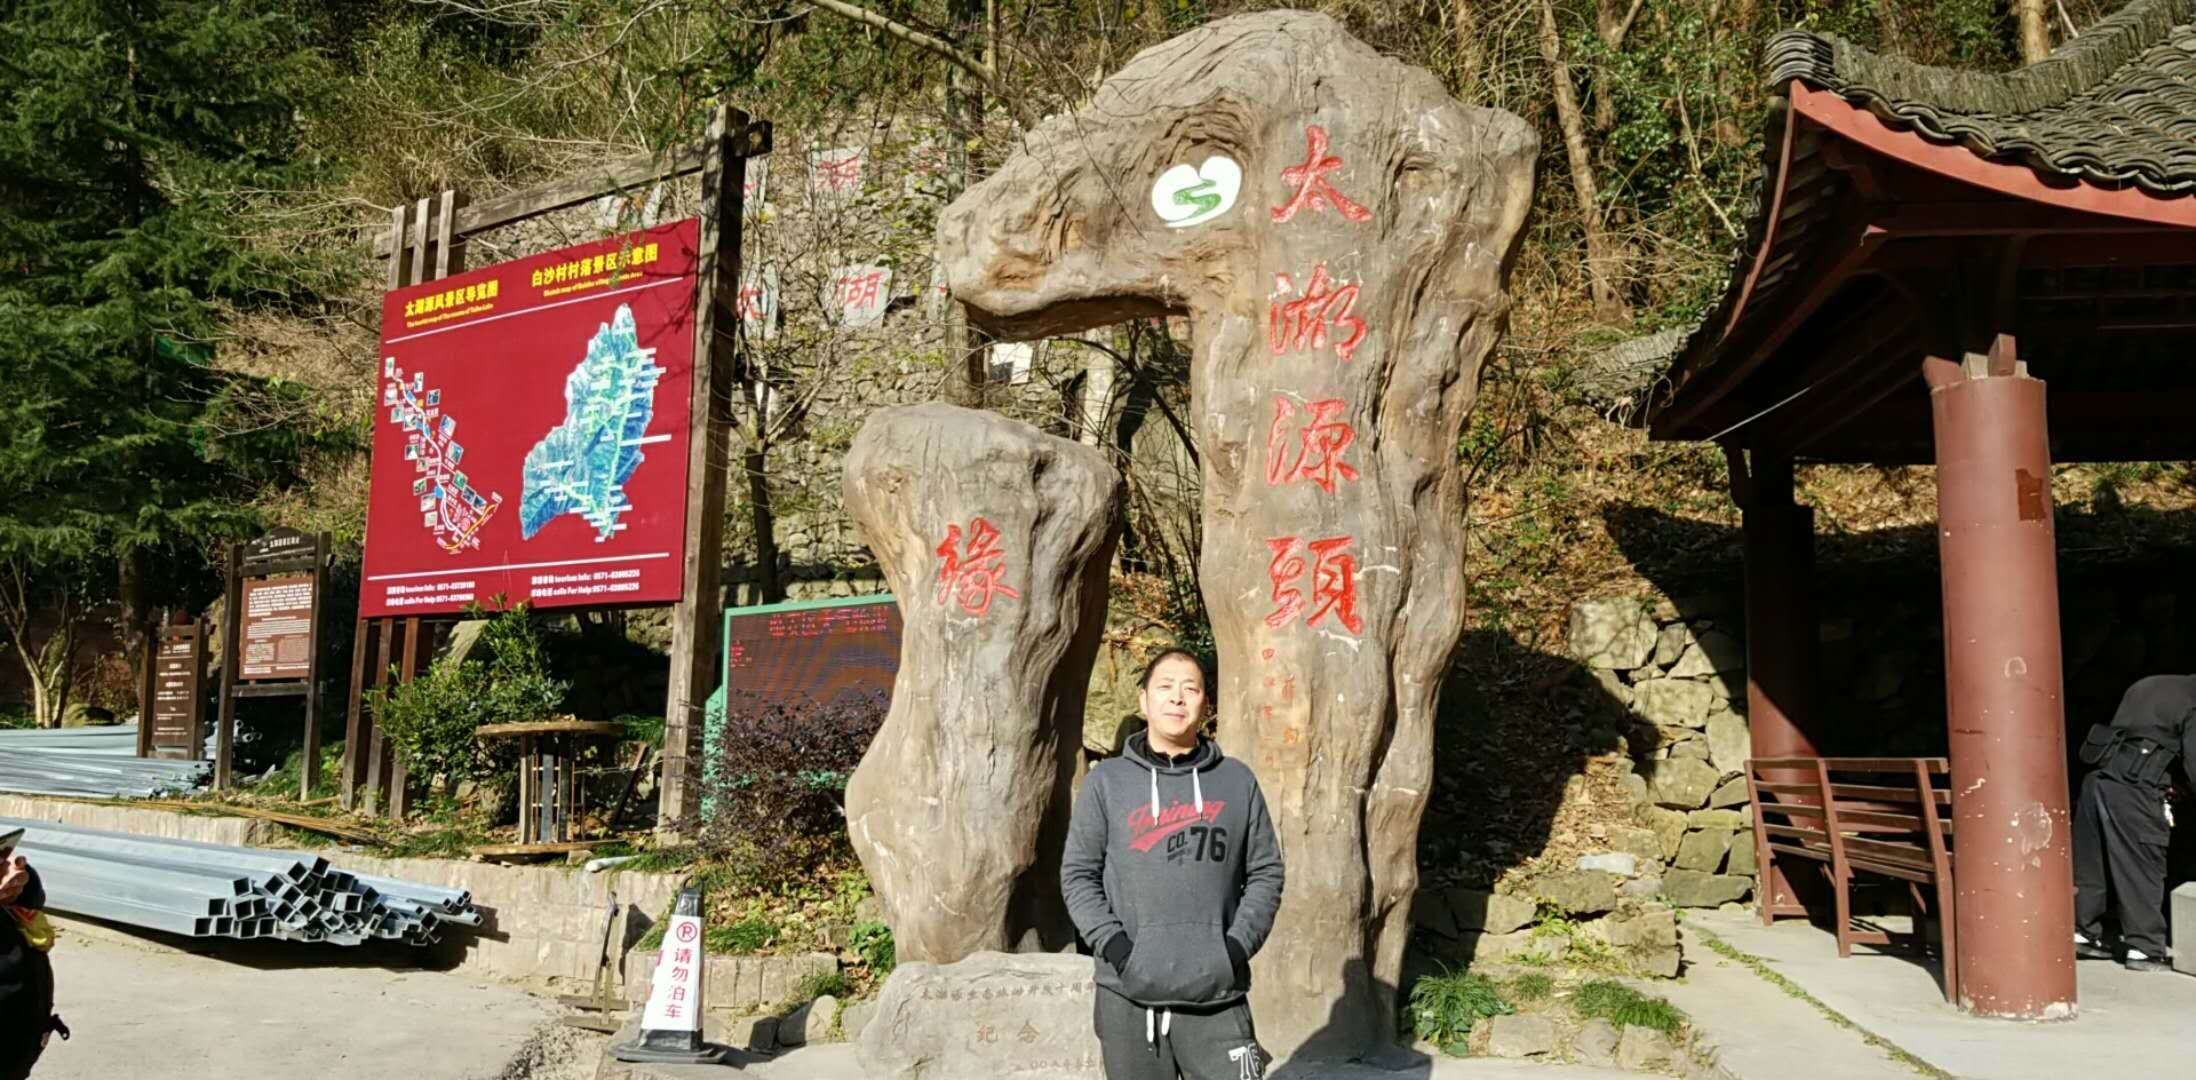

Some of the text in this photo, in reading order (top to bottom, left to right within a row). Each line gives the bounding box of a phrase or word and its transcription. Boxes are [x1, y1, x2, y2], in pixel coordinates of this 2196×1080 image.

[1189, 825, 1228, 863] 76
[665, 947, 694, 1019] 请勿泊车
[976, 1021, 1040, 1045] 纪念
